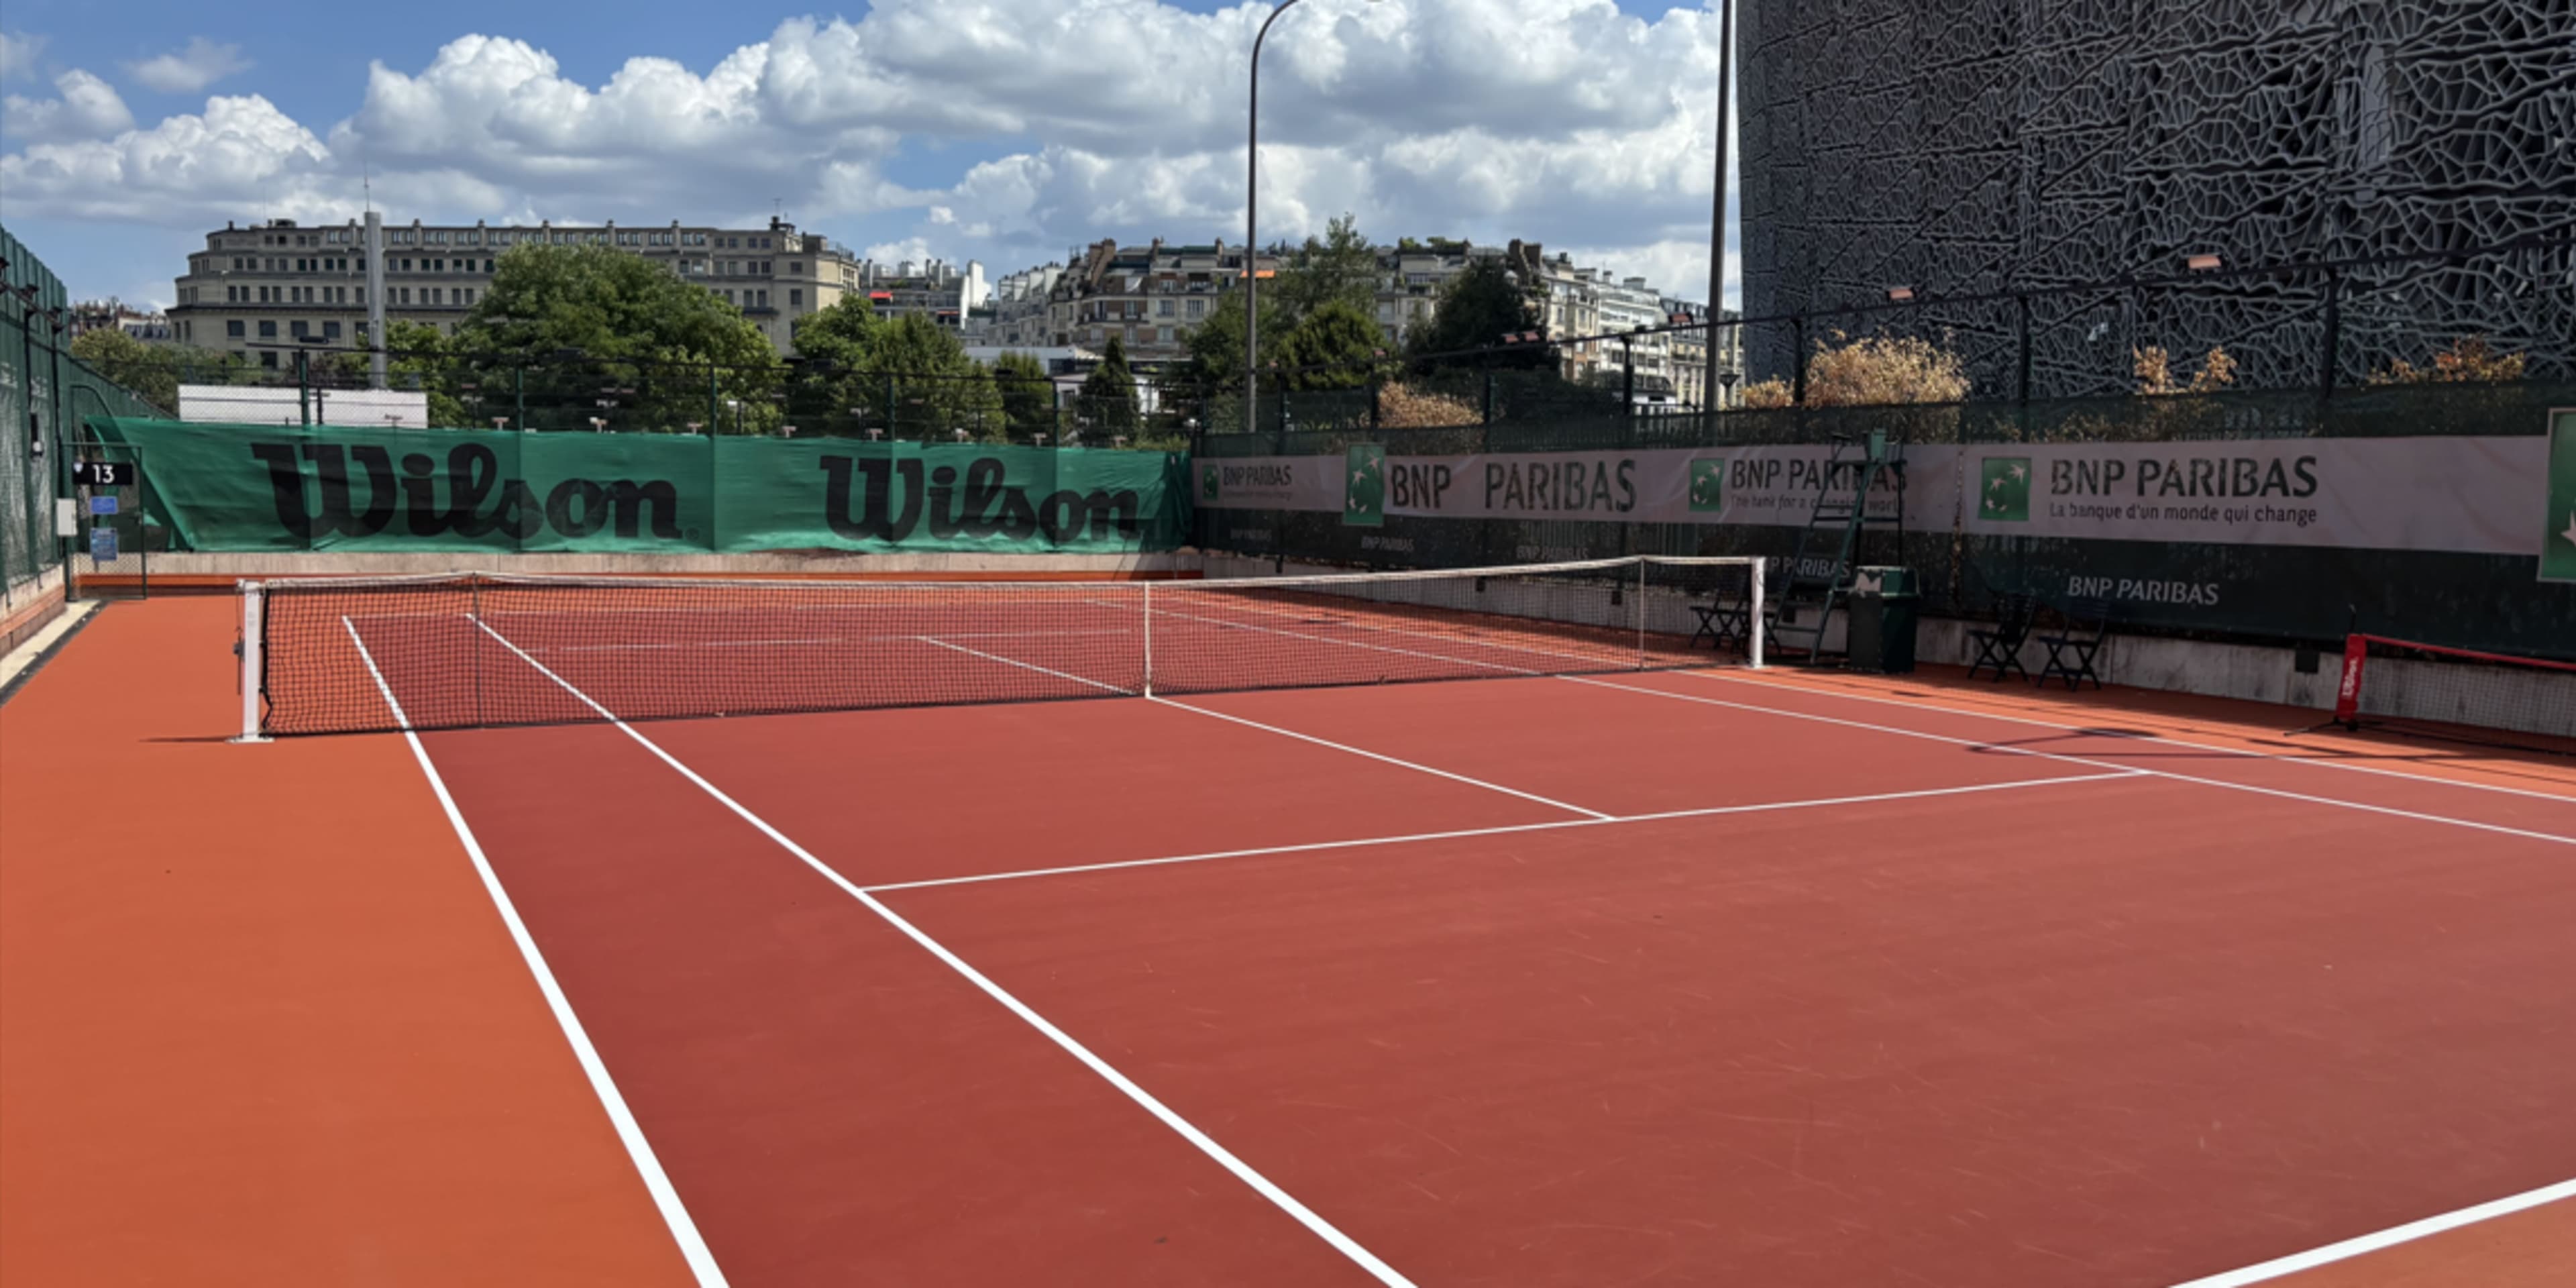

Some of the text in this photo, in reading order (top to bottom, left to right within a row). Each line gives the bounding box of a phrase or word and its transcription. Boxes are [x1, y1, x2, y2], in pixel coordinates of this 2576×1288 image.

[93, 464, 115, 483] 13
[1223, 464, 1293, 486] BNP PARIBAS
[1392, 459, 1637, 513] BNP PARIBAS
[1731, 460, 1781, 489] BNP
[2051, 455, 2318, 498] BNP PARIBAS
[251, 443, 682, 539] Wilson
[820, 455, 1140, 543] Wilson
[1778, 494, 1796, 511] for
[1799, 498, 1805, 508] a
[1868, 496, 1900, 513] worl
[2049, 502, 2317, 528] La banque d'un monde qui change
[2067, 576, 2220, 606] BNP PARIBAS
